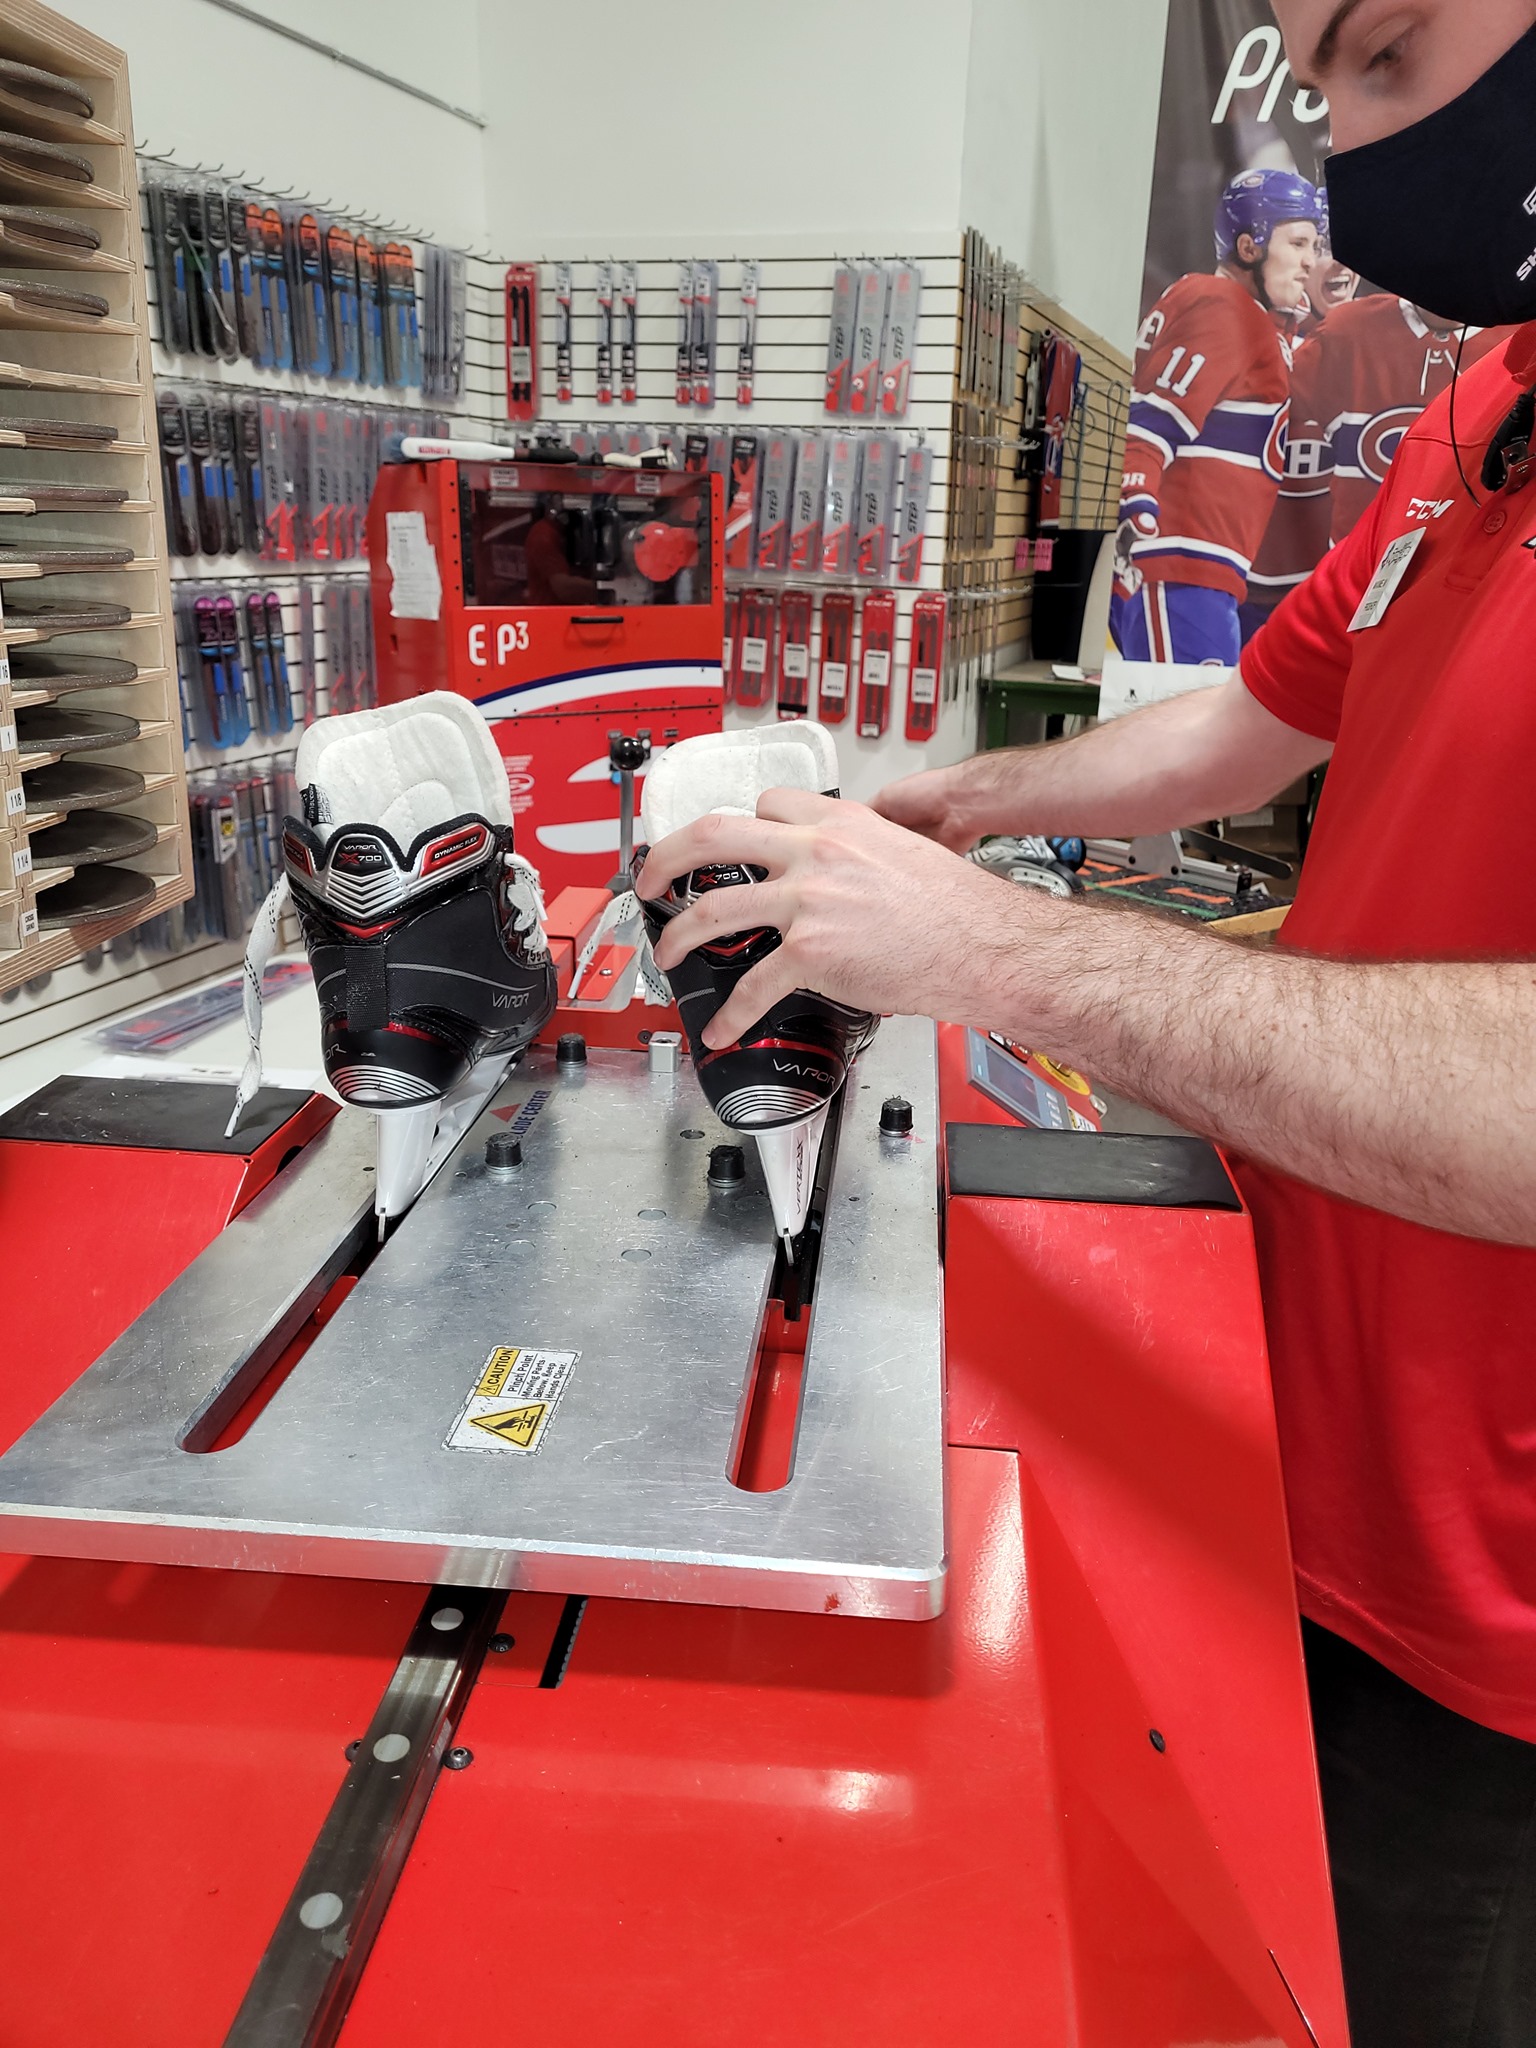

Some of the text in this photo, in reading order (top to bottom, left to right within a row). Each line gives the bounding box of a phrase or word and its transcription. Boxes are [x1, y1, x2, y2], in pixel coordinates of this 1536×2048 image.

[1156, 346, 1206, 398] 11
[1405, 497, 1455, 520] CCM
[338, 852, 382, 865] X700
[434, 835, 478, 860] DYNAMIC FLEX
[697, 871, 739, 888] X700
[492, 991, 530, 1008] VAPOR
[773, 1058, 836, 1092] VAPOR
[509, 1090, 552, 1138] LADE CENTER
[487, 1350, 515, 1385] CAUTION
[507, 1355, 533, 1392] Pinch Point
[521, 1359, 546, 1397] Moving Parts
[544, 1379, 560, 1399] Hands
